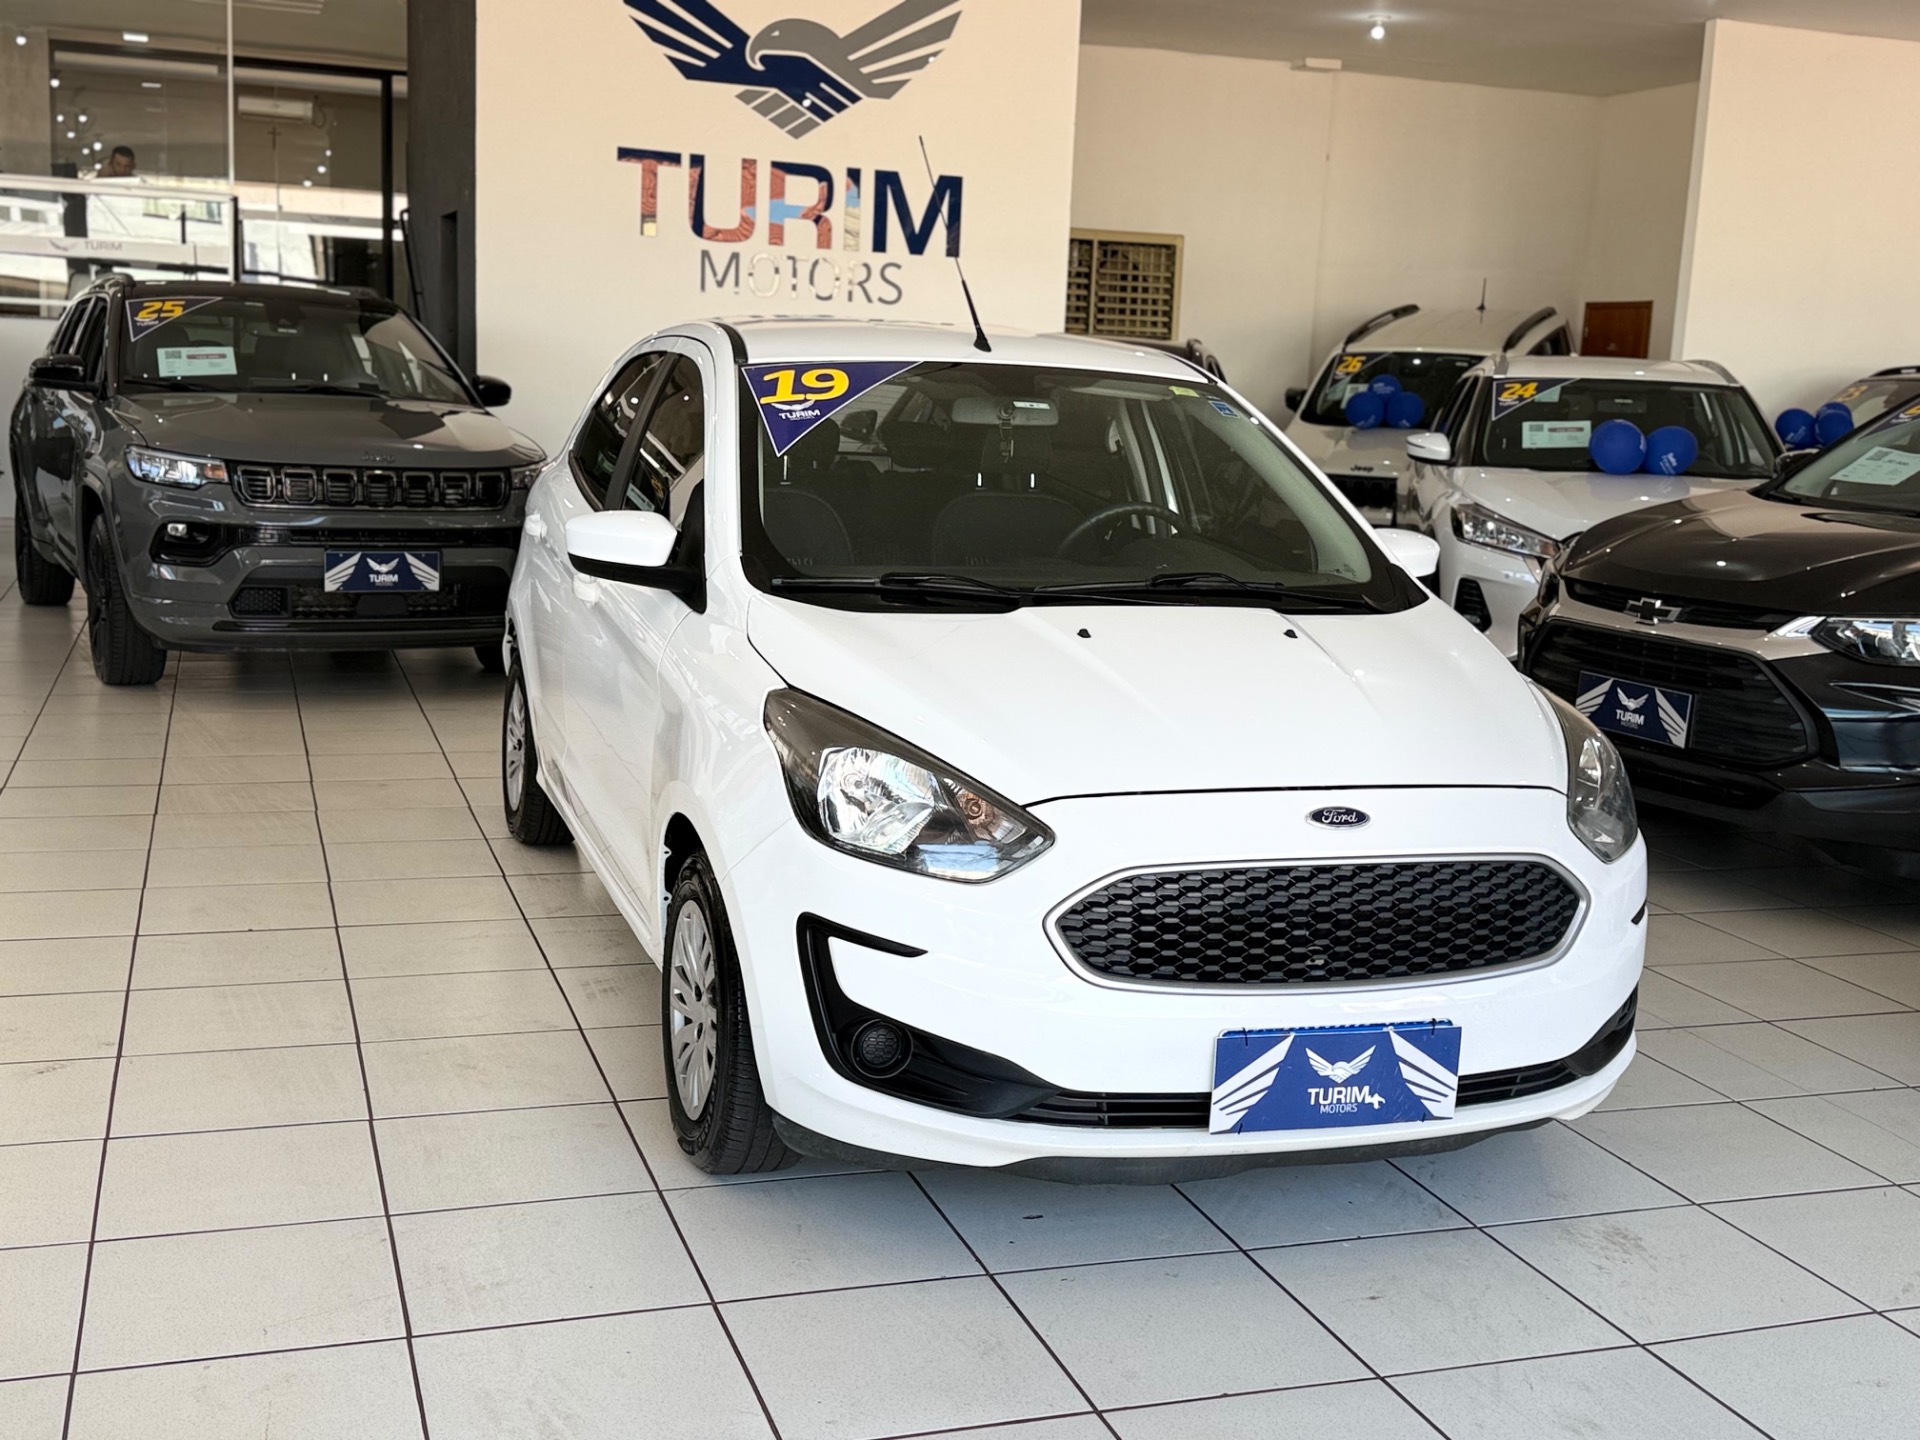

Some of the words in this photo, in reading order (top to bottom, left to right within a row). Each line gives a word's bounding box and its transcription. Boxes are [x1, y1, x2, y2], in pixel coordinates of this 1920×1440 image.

[617, 146, 963, 259] TURIM
[84, 240, 123, 251] TURIM
[699, 249, 904, 306] MOTORS
[137, 300, 186, 319] 25
[1335, 355, 1367, 373] 26
[759, 367, 850, 405] 19
[1500, 382, 1539, 400] 24
[778, 409, 821, 420] TURIM
[1350, 464, 1374, 473] Jeep
[368, 573, 399, 583] TURIM
[1615, 709, 1645, 726] TURIM
[1321, 808, 1359, 824] Ford
[1307, 1085, 1371, 1106] TURIM
[1320, 1103, 1358, 1114] MOTORS
